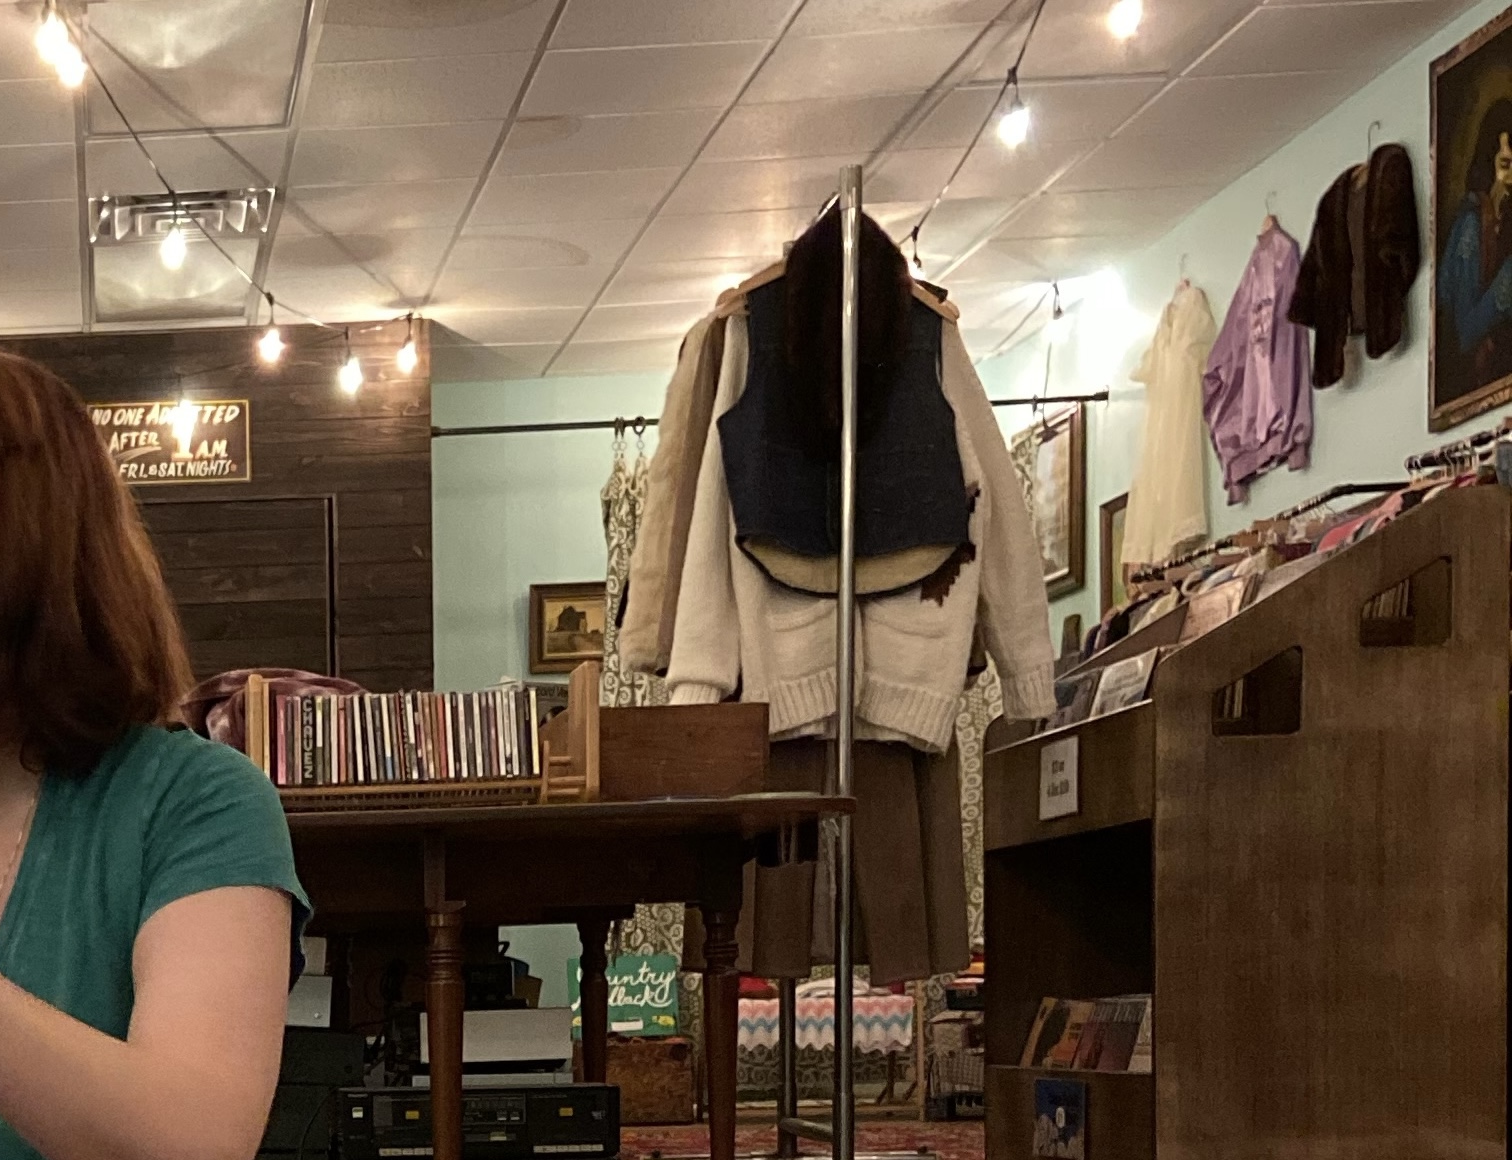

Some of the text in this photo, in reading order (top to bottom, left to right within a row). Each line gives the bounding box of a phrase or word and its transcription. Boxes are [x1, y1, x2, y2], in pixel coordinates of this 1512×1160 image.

[92, 402, 240, 426] NO ONE ADTED
[109, 431, 160, 453] AFTER
[185, 459, 232, 477] NIGHTS
